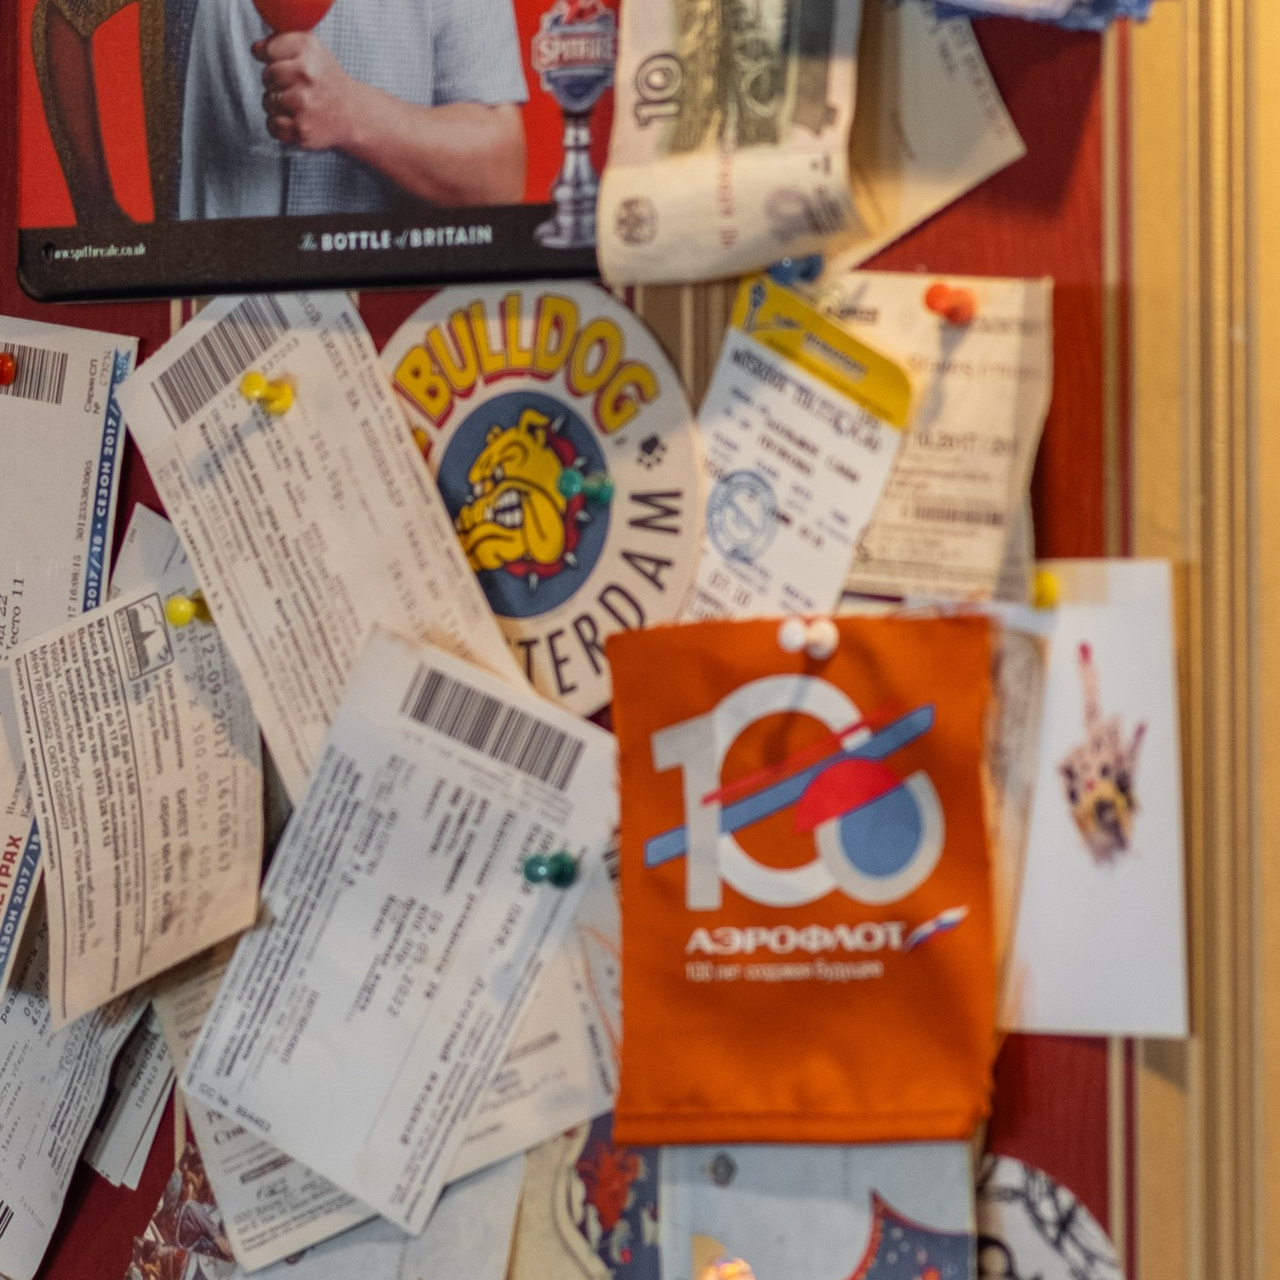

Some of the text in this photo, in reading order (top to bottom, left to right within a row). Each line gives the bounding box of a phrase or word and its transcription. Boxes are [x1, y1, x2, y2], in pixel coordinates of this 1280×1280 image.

[634, 51, 685, 127] 10
[321, 225, 492, 251] BOTTLE BRITAIN
[392, 292, 662, 436] BULLDOG
[95, 461, 112, 518] СЕЗОН
[685, 920, 907, 955] АЭРОФЛОТ
